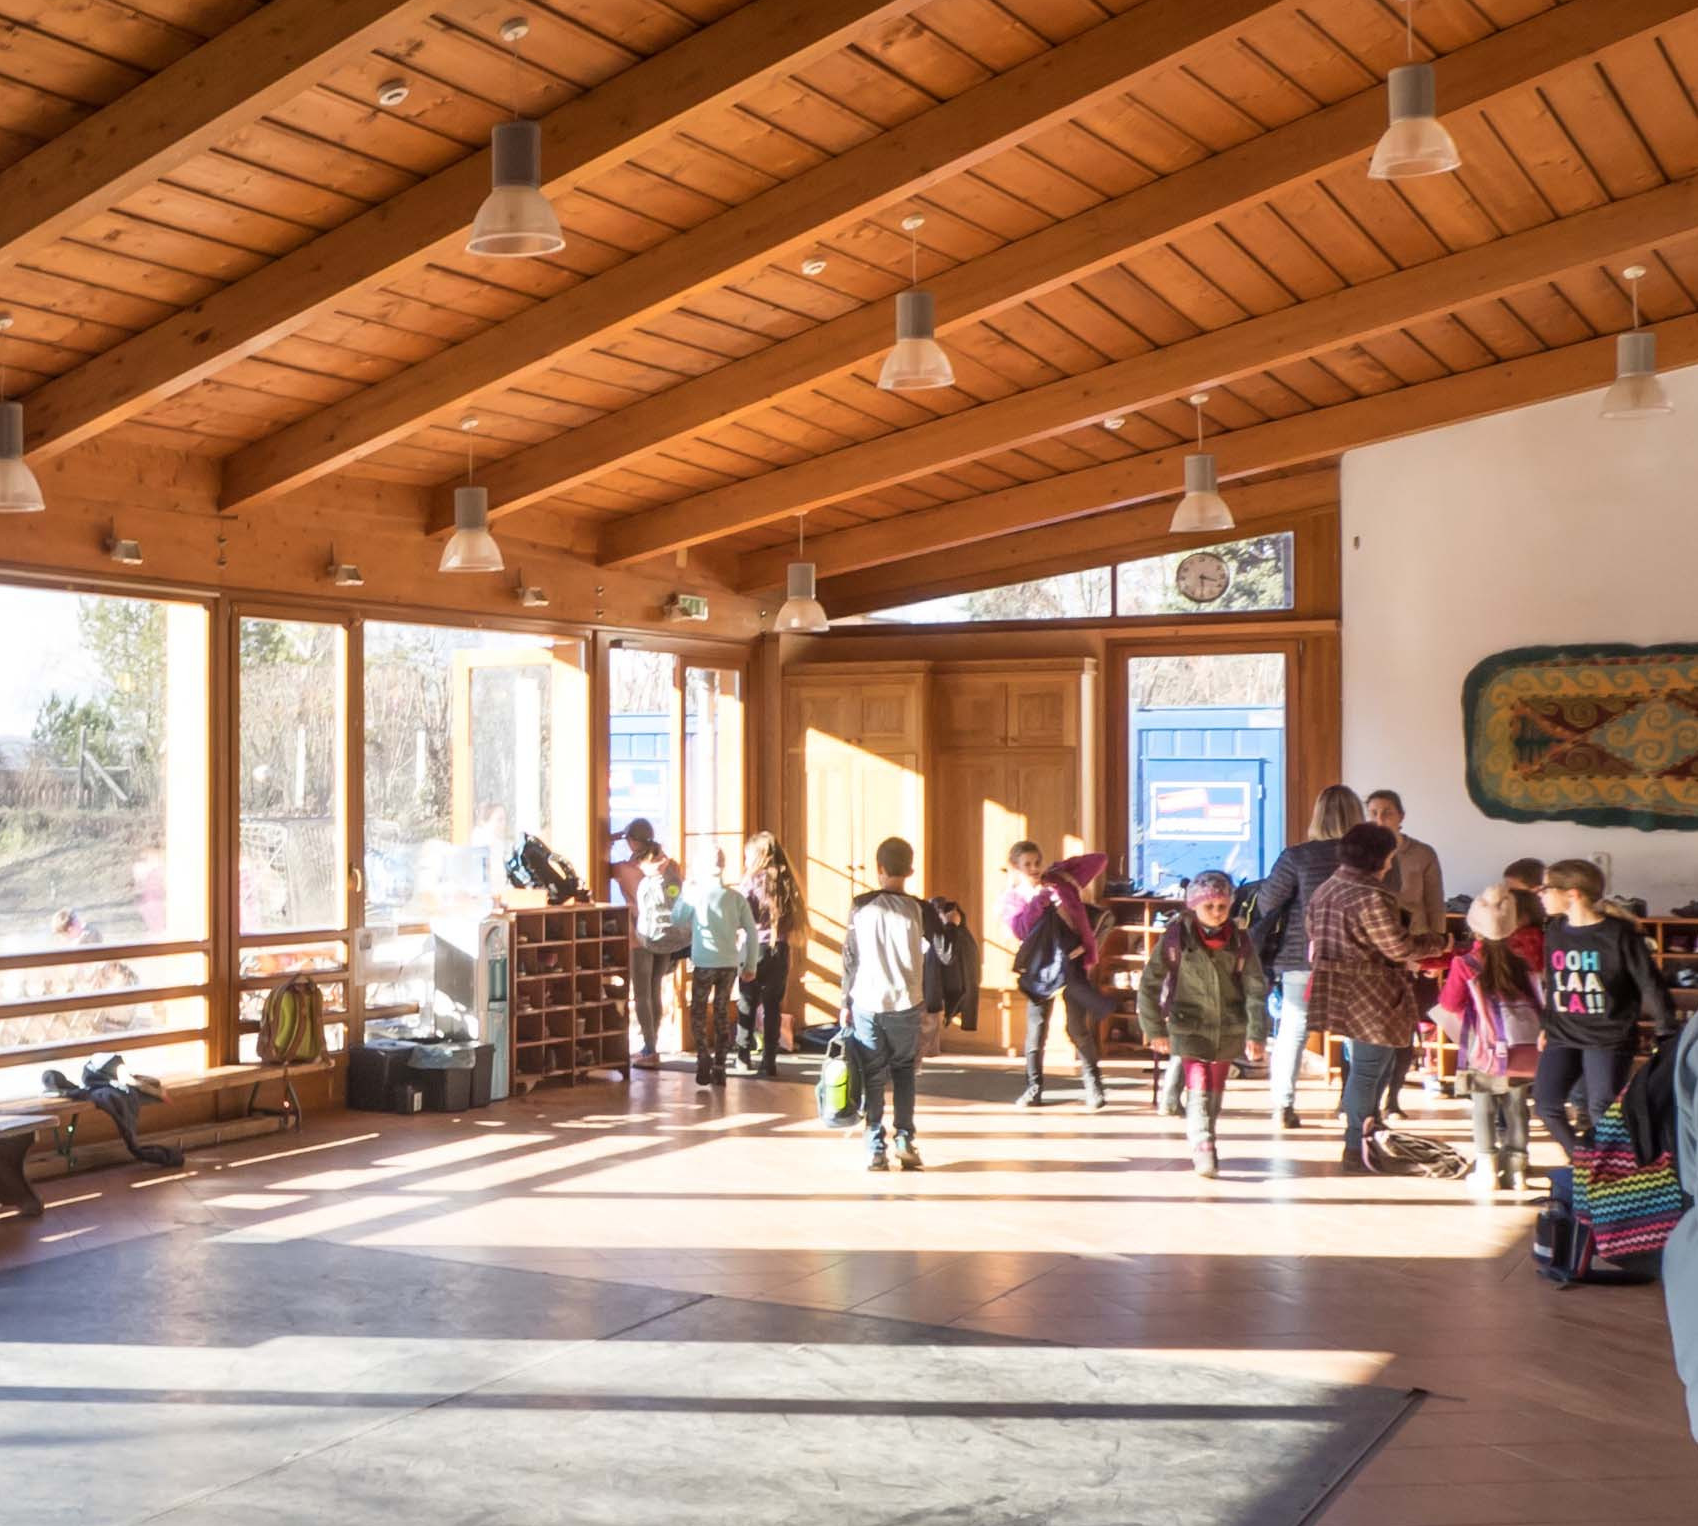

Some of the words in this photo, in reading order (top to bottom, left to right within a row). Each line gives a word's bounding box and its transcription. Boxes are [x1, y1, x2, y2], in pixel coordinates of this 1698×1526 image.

[1551, 949, 1599, 971] OOH
[1554, 971, 1605, 992] LAA
[1552, 991, 1605, 1013] LA!!
